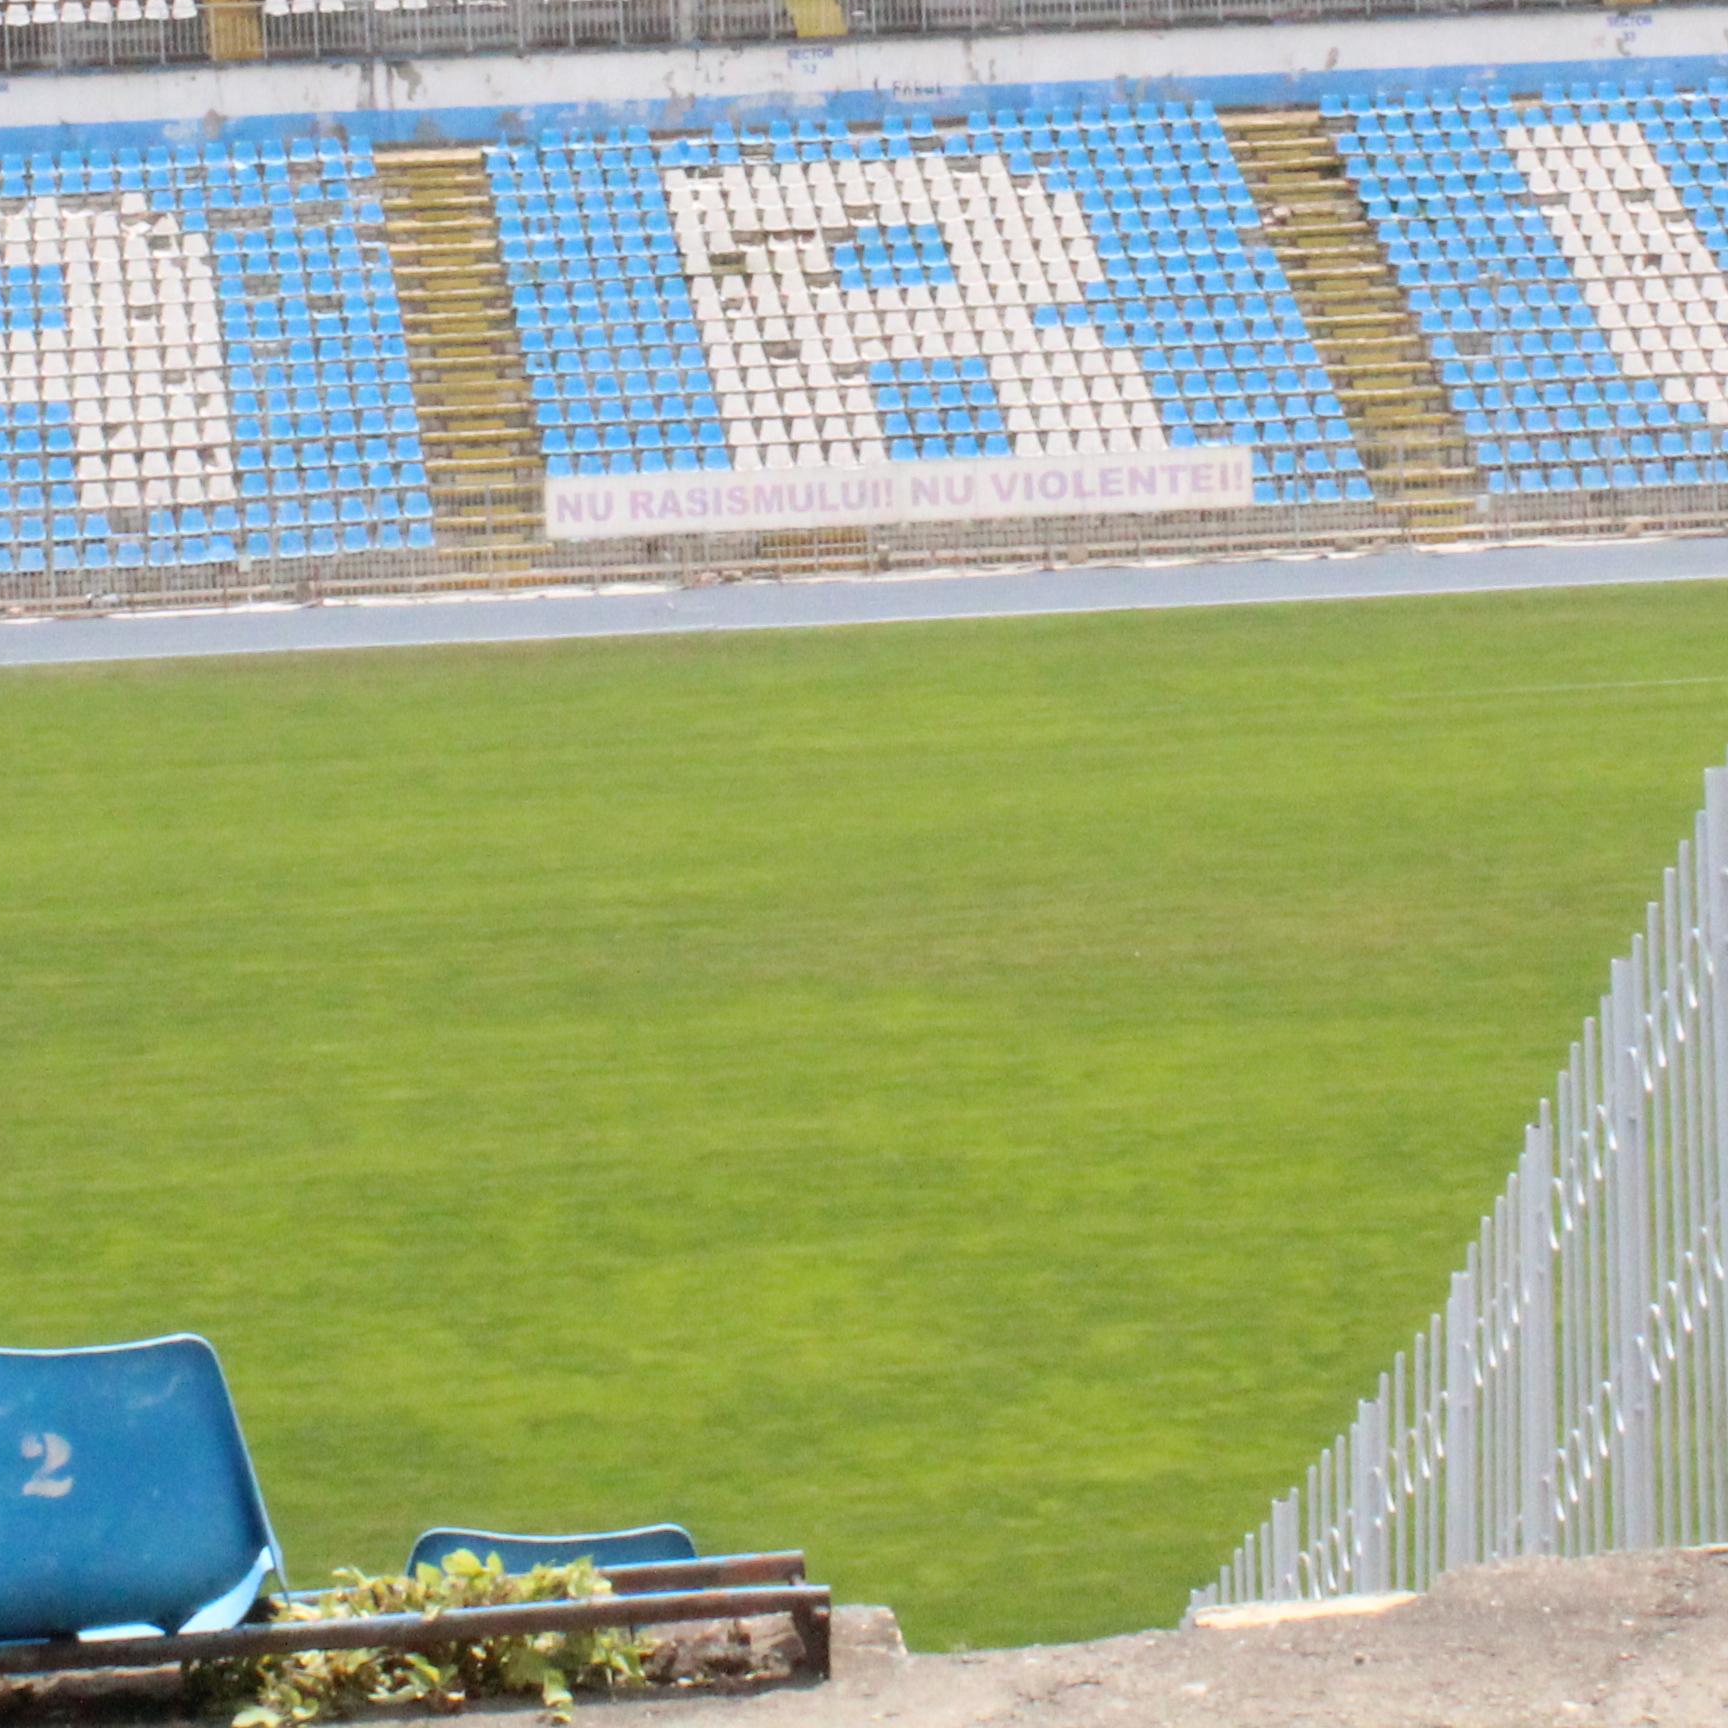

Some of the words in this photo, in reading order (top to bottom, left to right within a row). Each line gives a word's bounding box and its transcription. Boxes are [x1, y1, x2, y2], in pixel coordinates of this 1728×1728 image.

[555, 489, 613, 524] NU
[628, 478, 895, 519] RASISMULUI!
[910, 473, 975, 508] NU
[990, 462, 1246, 502] VIOLENTEI!
[20, 1432, 74, 1498] 2
